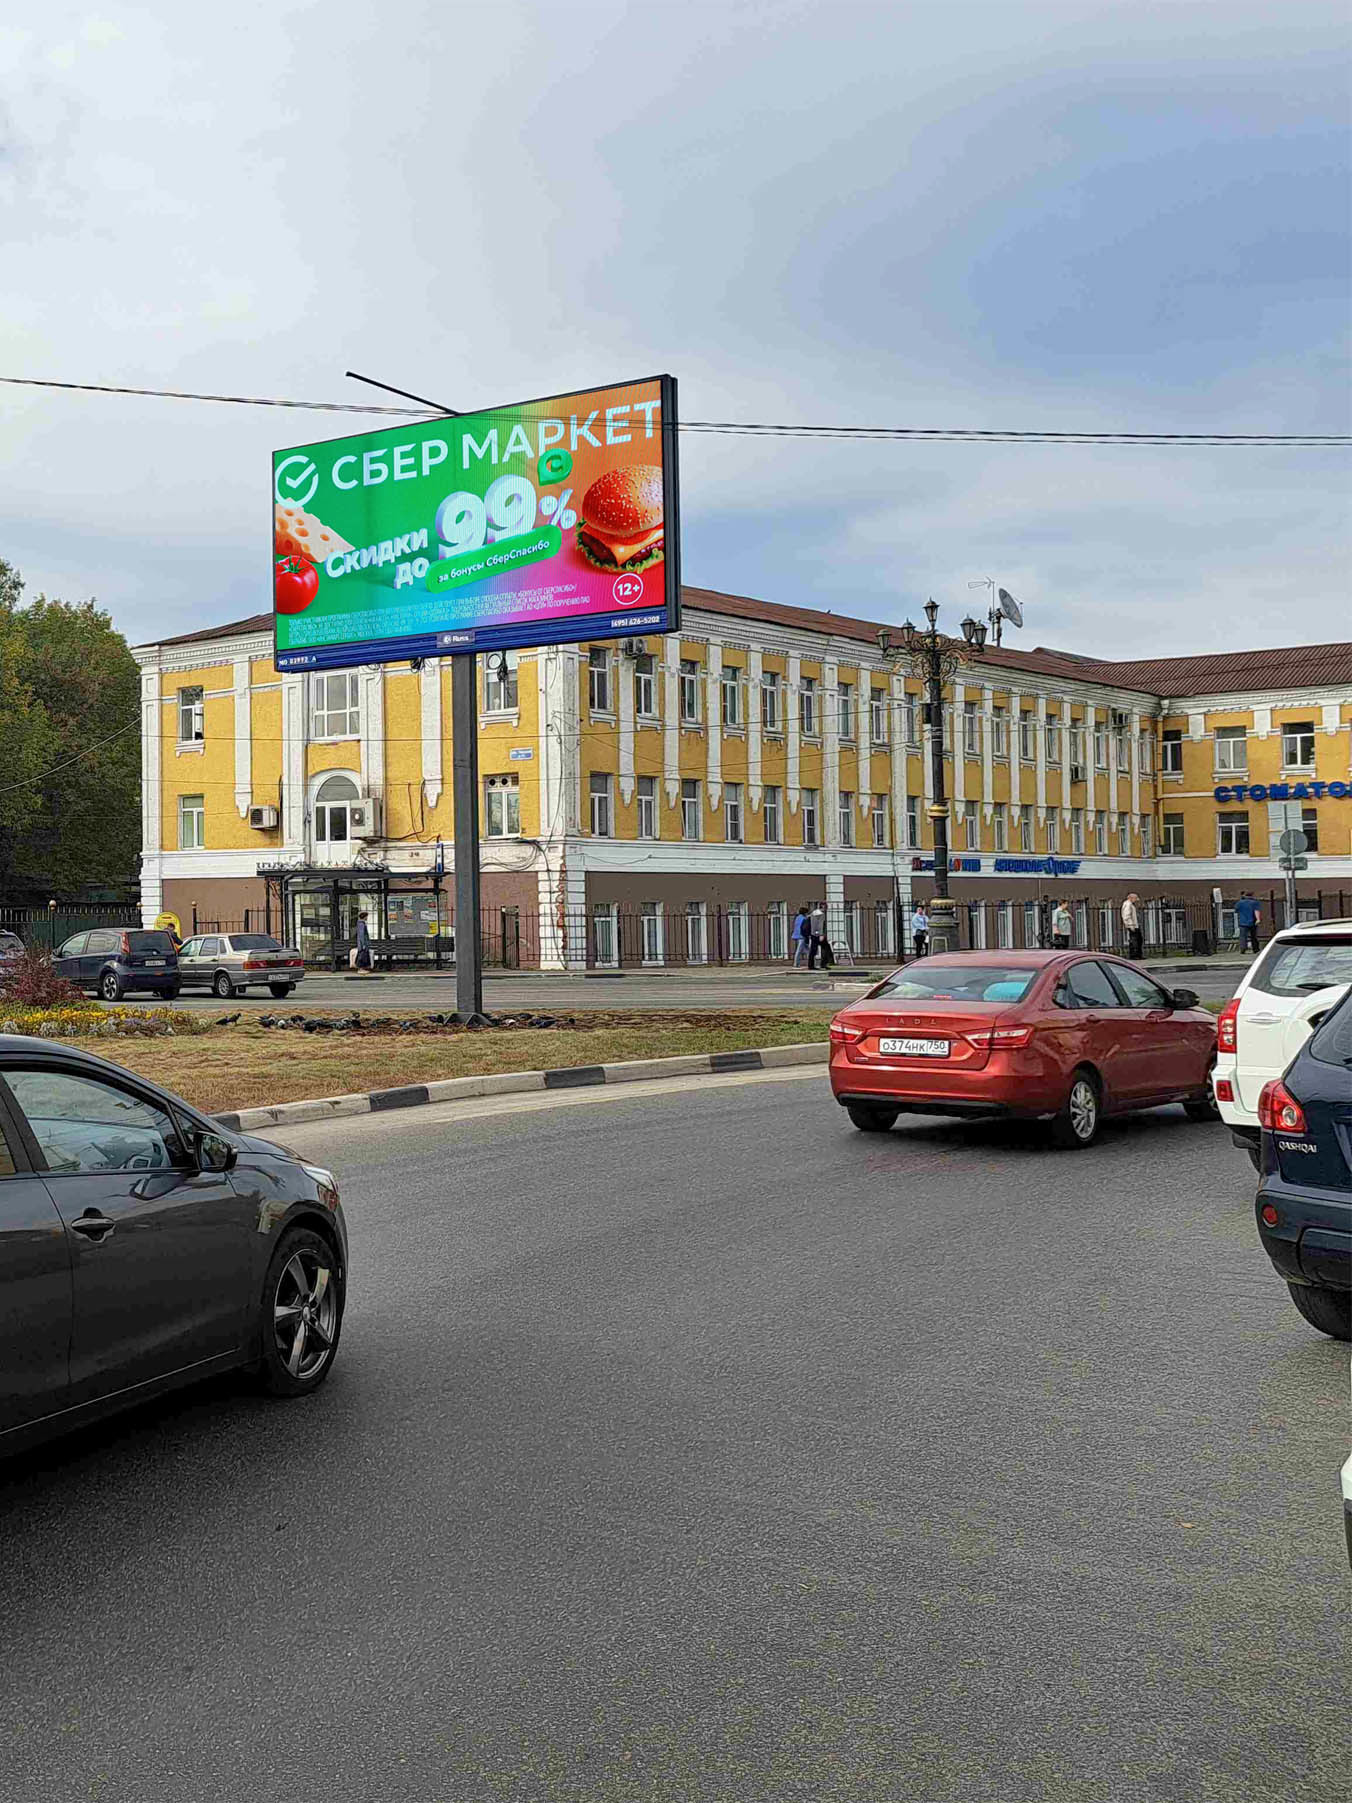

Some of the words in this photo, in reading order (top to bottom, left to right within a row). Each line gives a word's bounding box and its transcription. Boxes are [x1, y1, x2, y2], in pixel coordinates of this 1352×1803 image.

[331, 439, 449, 490] СБЕР
[462, 399, 661, 469] МАРКЕТ
[435, 474, 578, 560] 99%
[324, 527, 429, 579] Скидки
[438, 572, 449, 583] за
[450, 561, 485, 579] бонусы
[485, 539, 550, 568] СберСпасибо
[394, 557, 431, 590] до
[617, 582, 640, 597] 12+
[928, 1040, 946, 1050] 750
[1278, 1141, 1318, 1154] QASHQAI
